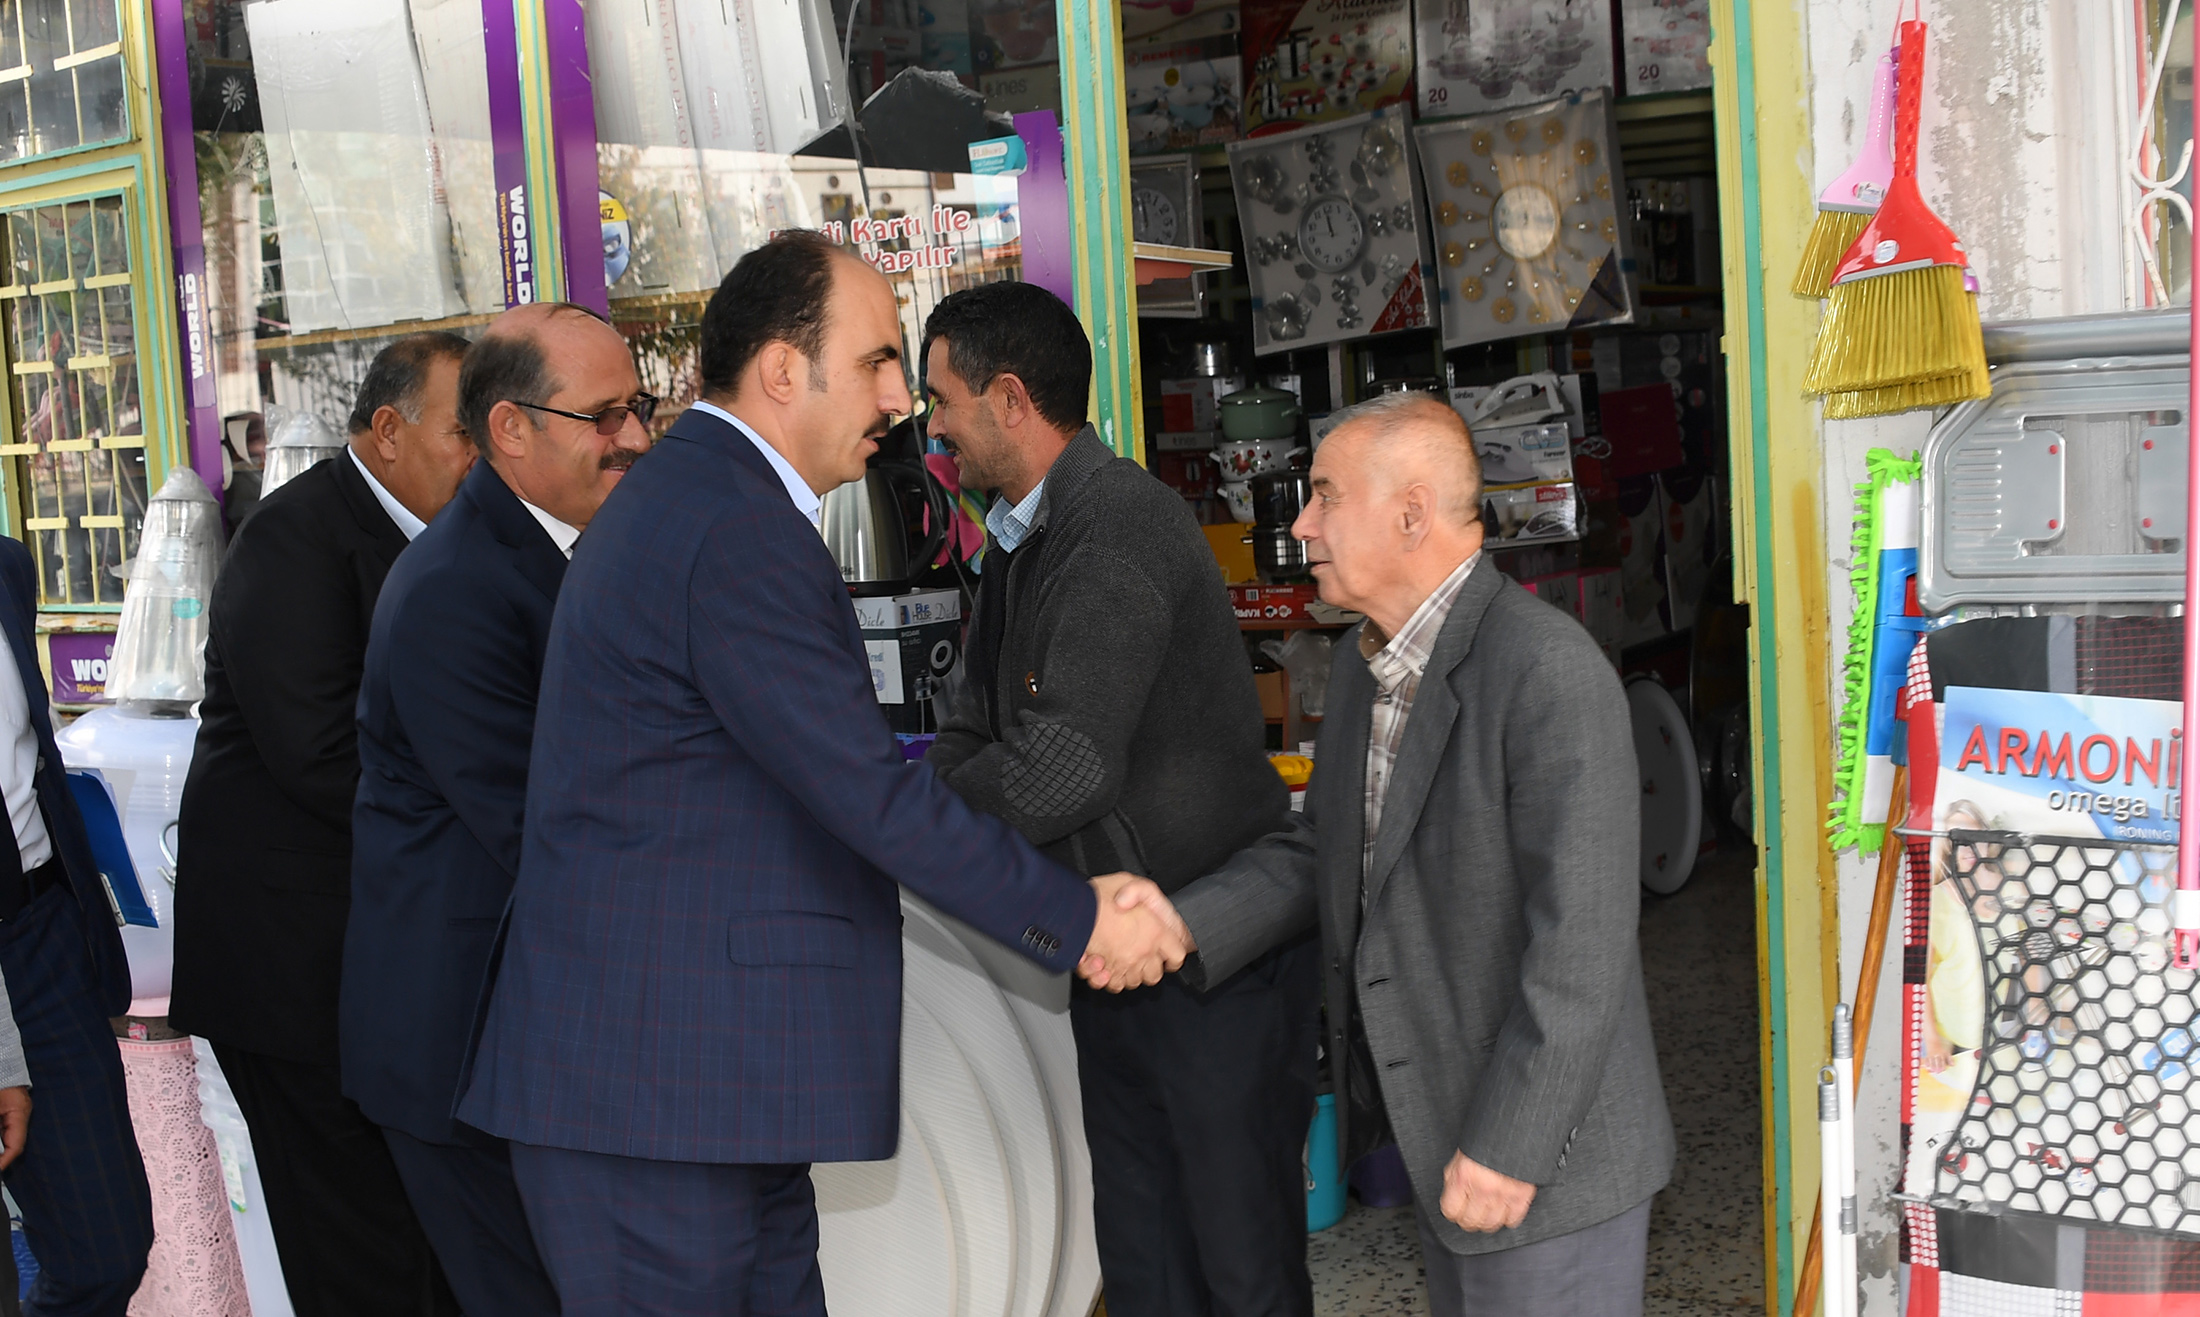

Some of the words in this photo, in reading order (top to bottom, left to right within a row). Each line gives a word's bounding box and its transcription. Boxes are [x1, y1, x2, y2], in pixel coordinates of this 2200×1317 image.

[1638, 64, 1659, 81] 20
[1428, 87, 1447, 104] 20
[852, 215, 921, 243] Kartı
[510, 185, 531, 305] WORLD
[864, 245, 955, 271] Yapılır
[185, 273, 203, 379] WORLD
[856, 608, 885, 627] Dicle
[2048, 789, 2148, 823] omega
[2112, 825, 2172, 842] IRONING
